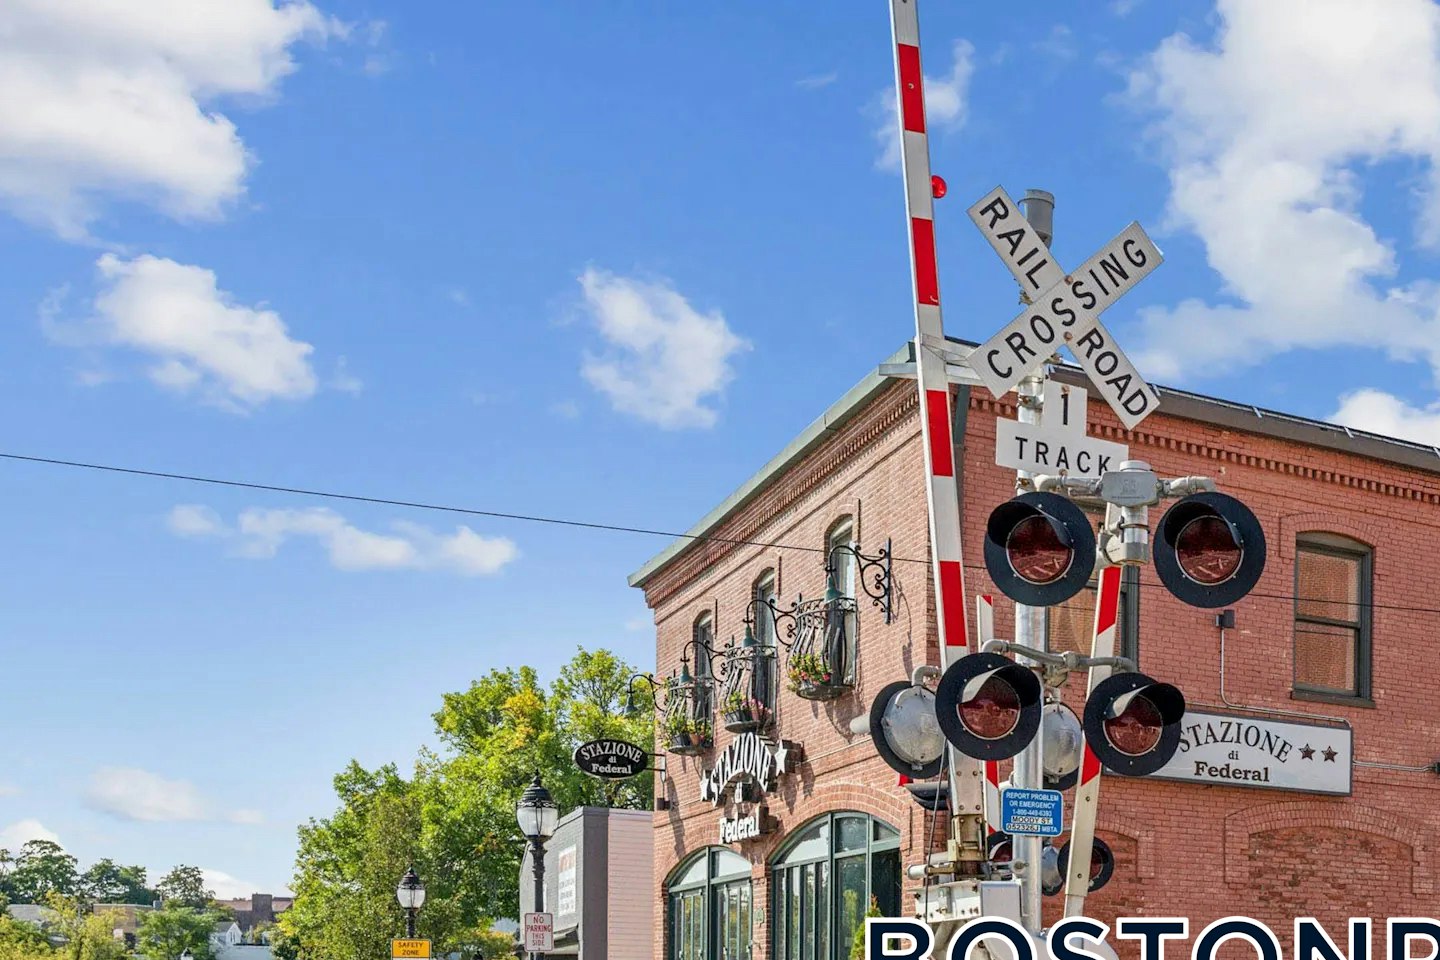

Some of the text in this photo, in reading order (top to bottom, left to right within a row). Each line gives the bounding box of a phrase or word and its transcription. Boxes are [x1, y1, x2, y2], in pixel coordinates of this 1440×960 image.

[979, 196, 1050, 290] RAIL
[987, 239, 1148, 379] CROSSING
[1077, 327, 1149, 418] ROAD
[1061, 393, 1070, 426] 1
[1015, 436, 1113, 476] TRACK
[580, 741, 643, 763] STAZIONE
[1178, 721, 1293, 763] STAZIONE
[608, 756, 617, 764] di
[1228, 750, 1239, 761] di
[592, 764, 632, 775] Federal
[710, 732, 772, 807] STAZIONE
[1194, 761, 1270, 783] Federal
[1006, 792, 1059, 802] REPORT PROBLEM
[1019, 801, 1056, 809] EMERGENCY
[719, 805, 760, 844] Federal
[527, 924, 551, 933] PARKING
[533, 916, 544, 924] NO
